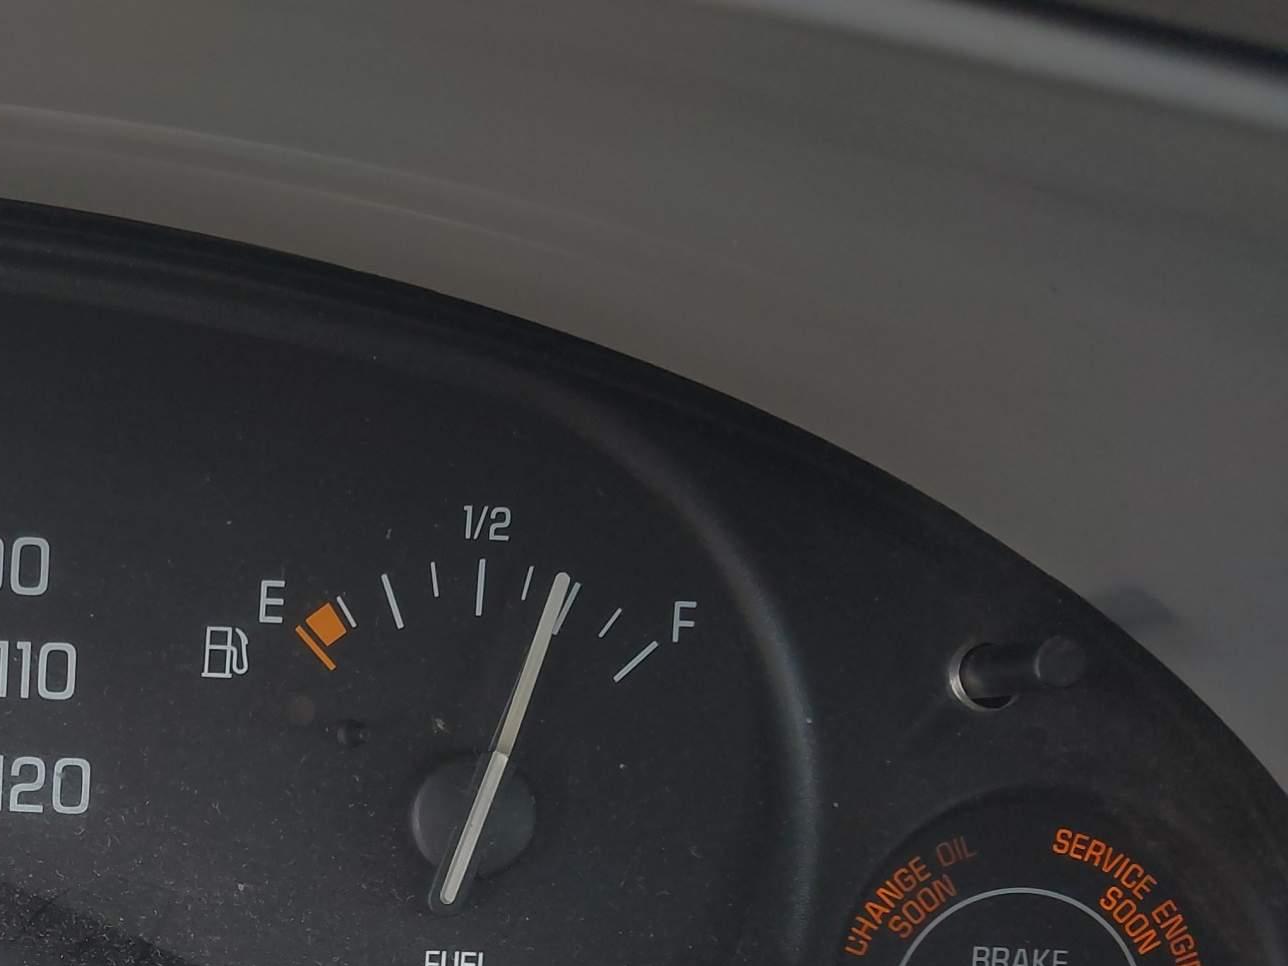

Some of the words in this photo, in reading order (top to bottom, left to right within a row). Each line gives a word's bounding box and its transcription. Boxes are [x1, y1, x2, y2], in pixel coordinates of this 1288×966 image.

[464, 506, 510, 540] 1/2
[259, 580, 285, 623] E
[673, 601, 696, 642] F
[845, 857, 931, 956] CHANGE
[937, 837, 976, 867] OIL
[1053, 829, 1157, 900] SERVICE
[889, 874, 957, 938] SOON
[1100, 887, 1161, 955] SOON
